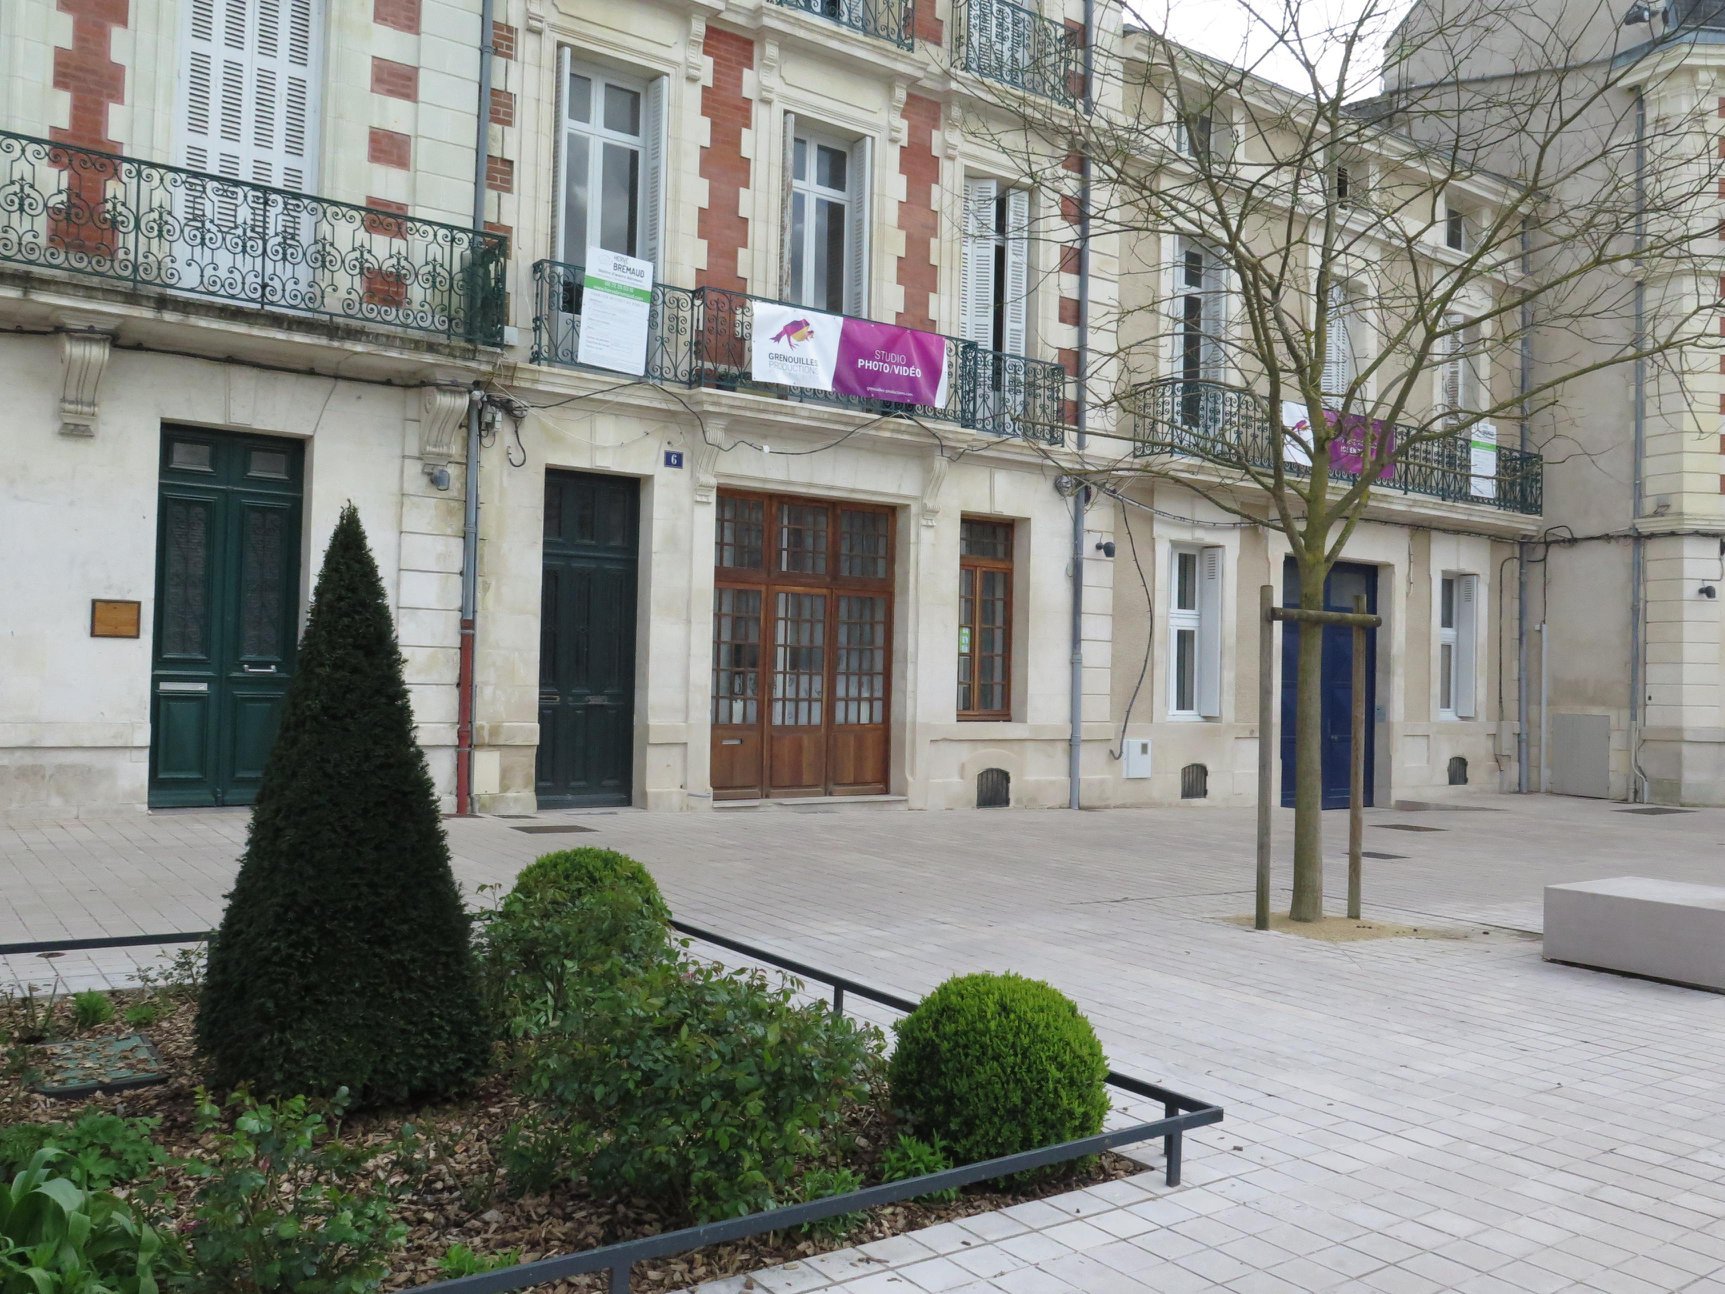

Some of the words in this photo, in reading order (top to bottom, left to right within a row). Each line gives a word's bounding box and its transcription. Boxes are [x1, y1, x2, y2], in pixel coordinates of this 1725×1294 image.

[768, 352, 818, 366] GRENOUILLES
[874, 350, 906, 364] STUDIO
[858, 358, 922, 378] PHOTO/VIDÉO
[671, 454, 677, 465] 6
